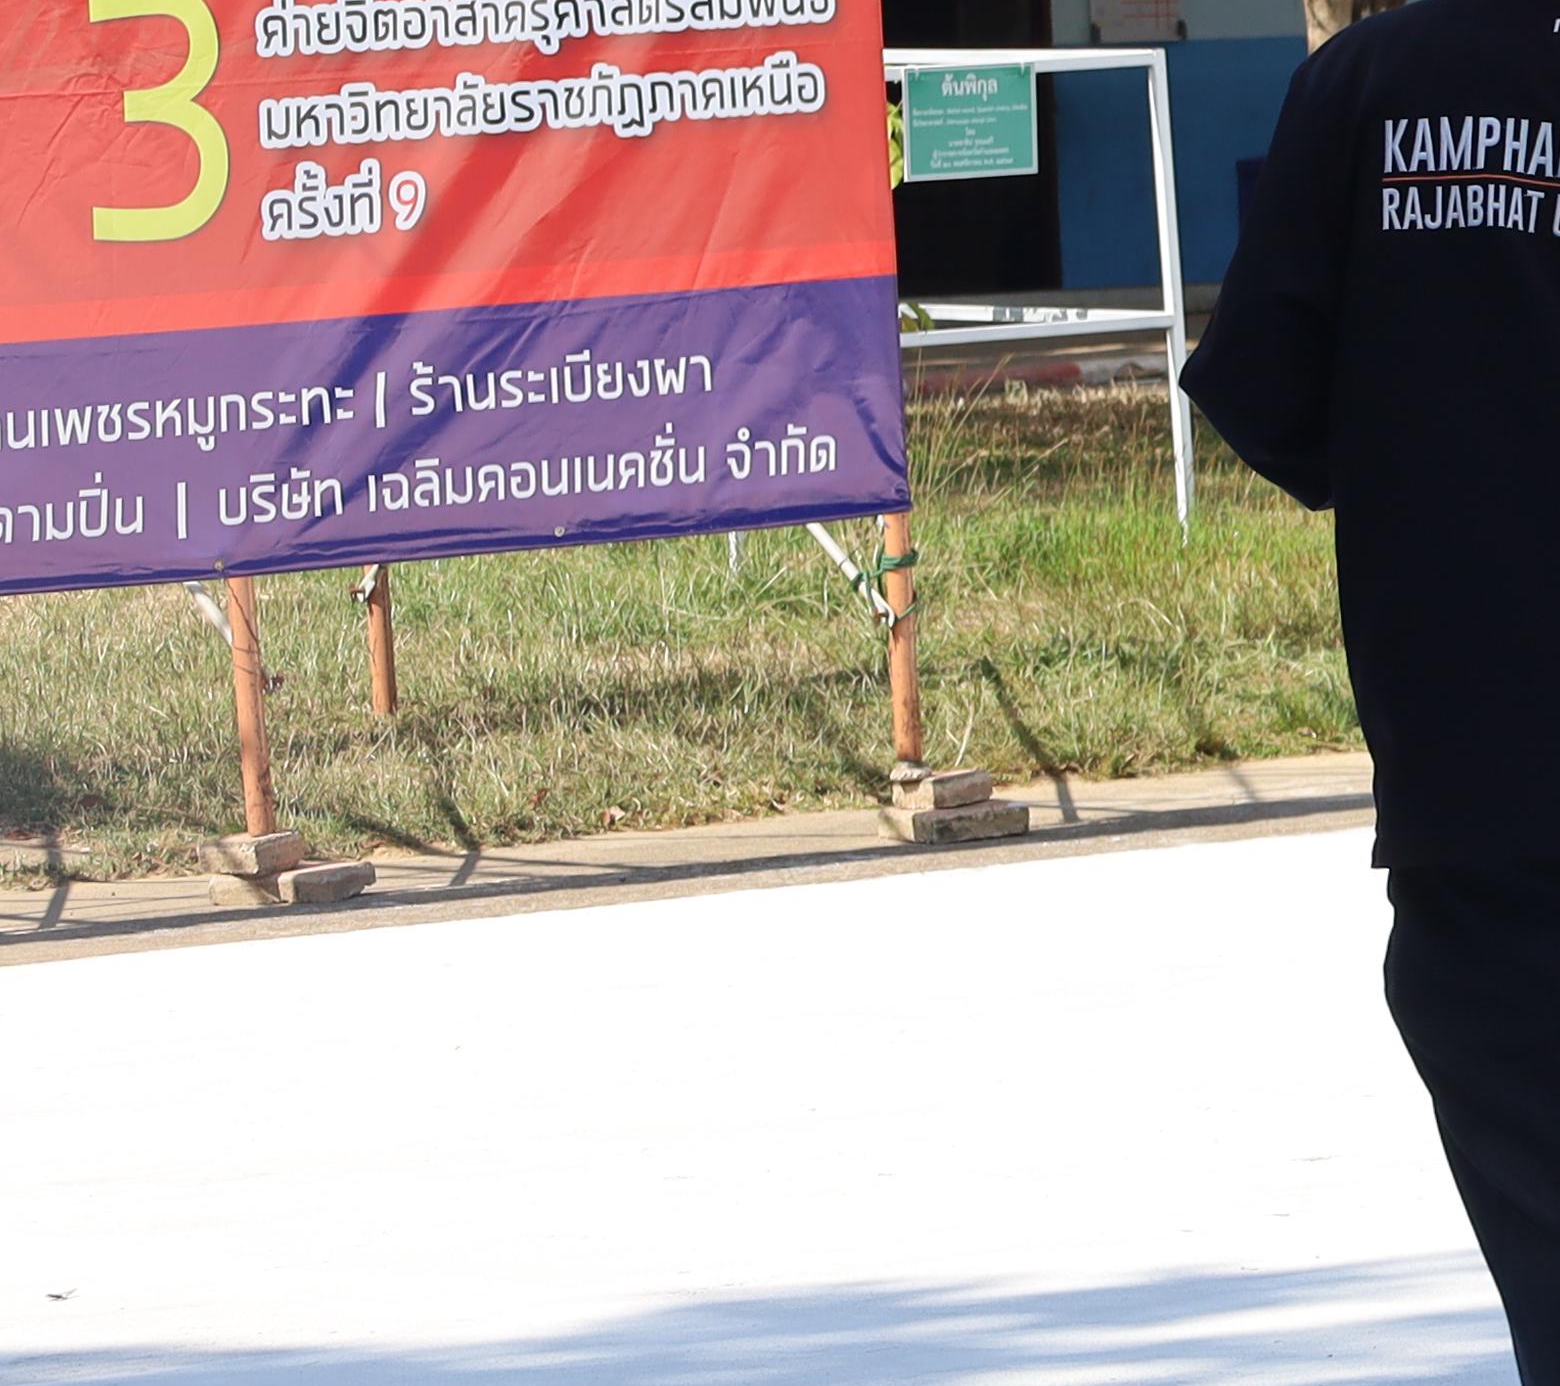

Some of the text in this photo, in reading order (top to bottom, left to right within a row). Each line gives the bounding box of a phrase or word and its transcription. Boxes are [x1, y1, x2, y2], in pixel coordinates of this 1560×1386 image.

[262, 55, 822, 144] มหาวิทยาลัยราชภัฏภาคเหนือ
[942, 73, 998, 102] ต้นพิกุล
[264, 162, 422, 235] ครั้งที่ 9
[1381, 183, 1544, 234] RAJABHAT
[0, 386, 354, 451] นเพชรหมูกระทะ
[409, 349, 712, 415] ร้านระเบียงผา
[219, 468, 343, 525] บริษัท
[369, 422, 705, 511] เฉลิมคอนเนคชั่น
[727, 424, 836, 480] จำกัด
